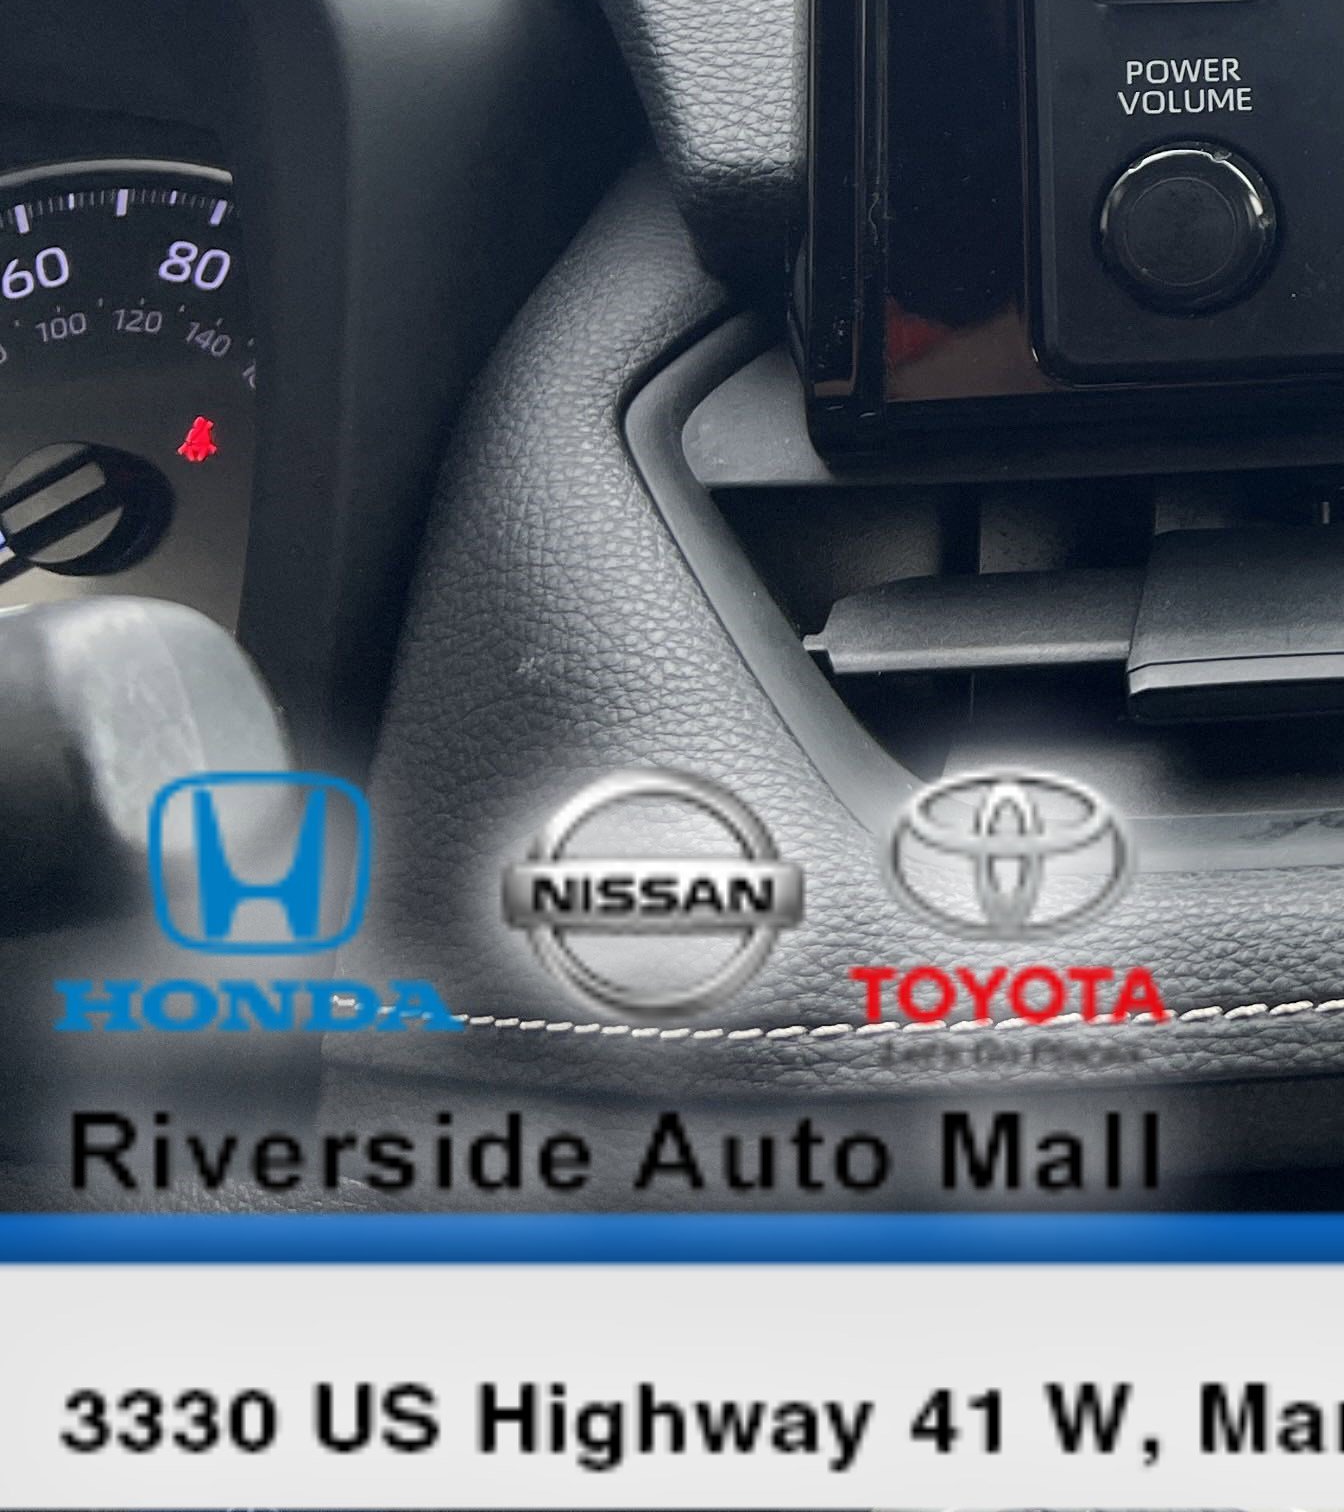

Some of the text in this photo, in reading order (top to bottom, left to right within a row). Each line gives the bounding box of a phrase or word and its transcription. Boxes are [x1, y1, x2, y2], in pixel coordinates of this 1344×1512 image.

[1126, 59, 1241, 85] POWER
[1119, 89, 1253, 116] VOLUME
[2, 247, 69, 299] 60
[158, 240, 231, 290] 80
[35, 312, 87, 342] 100
[112, 308, 163, 333] 120
[185, 322, 232, 357] 140
